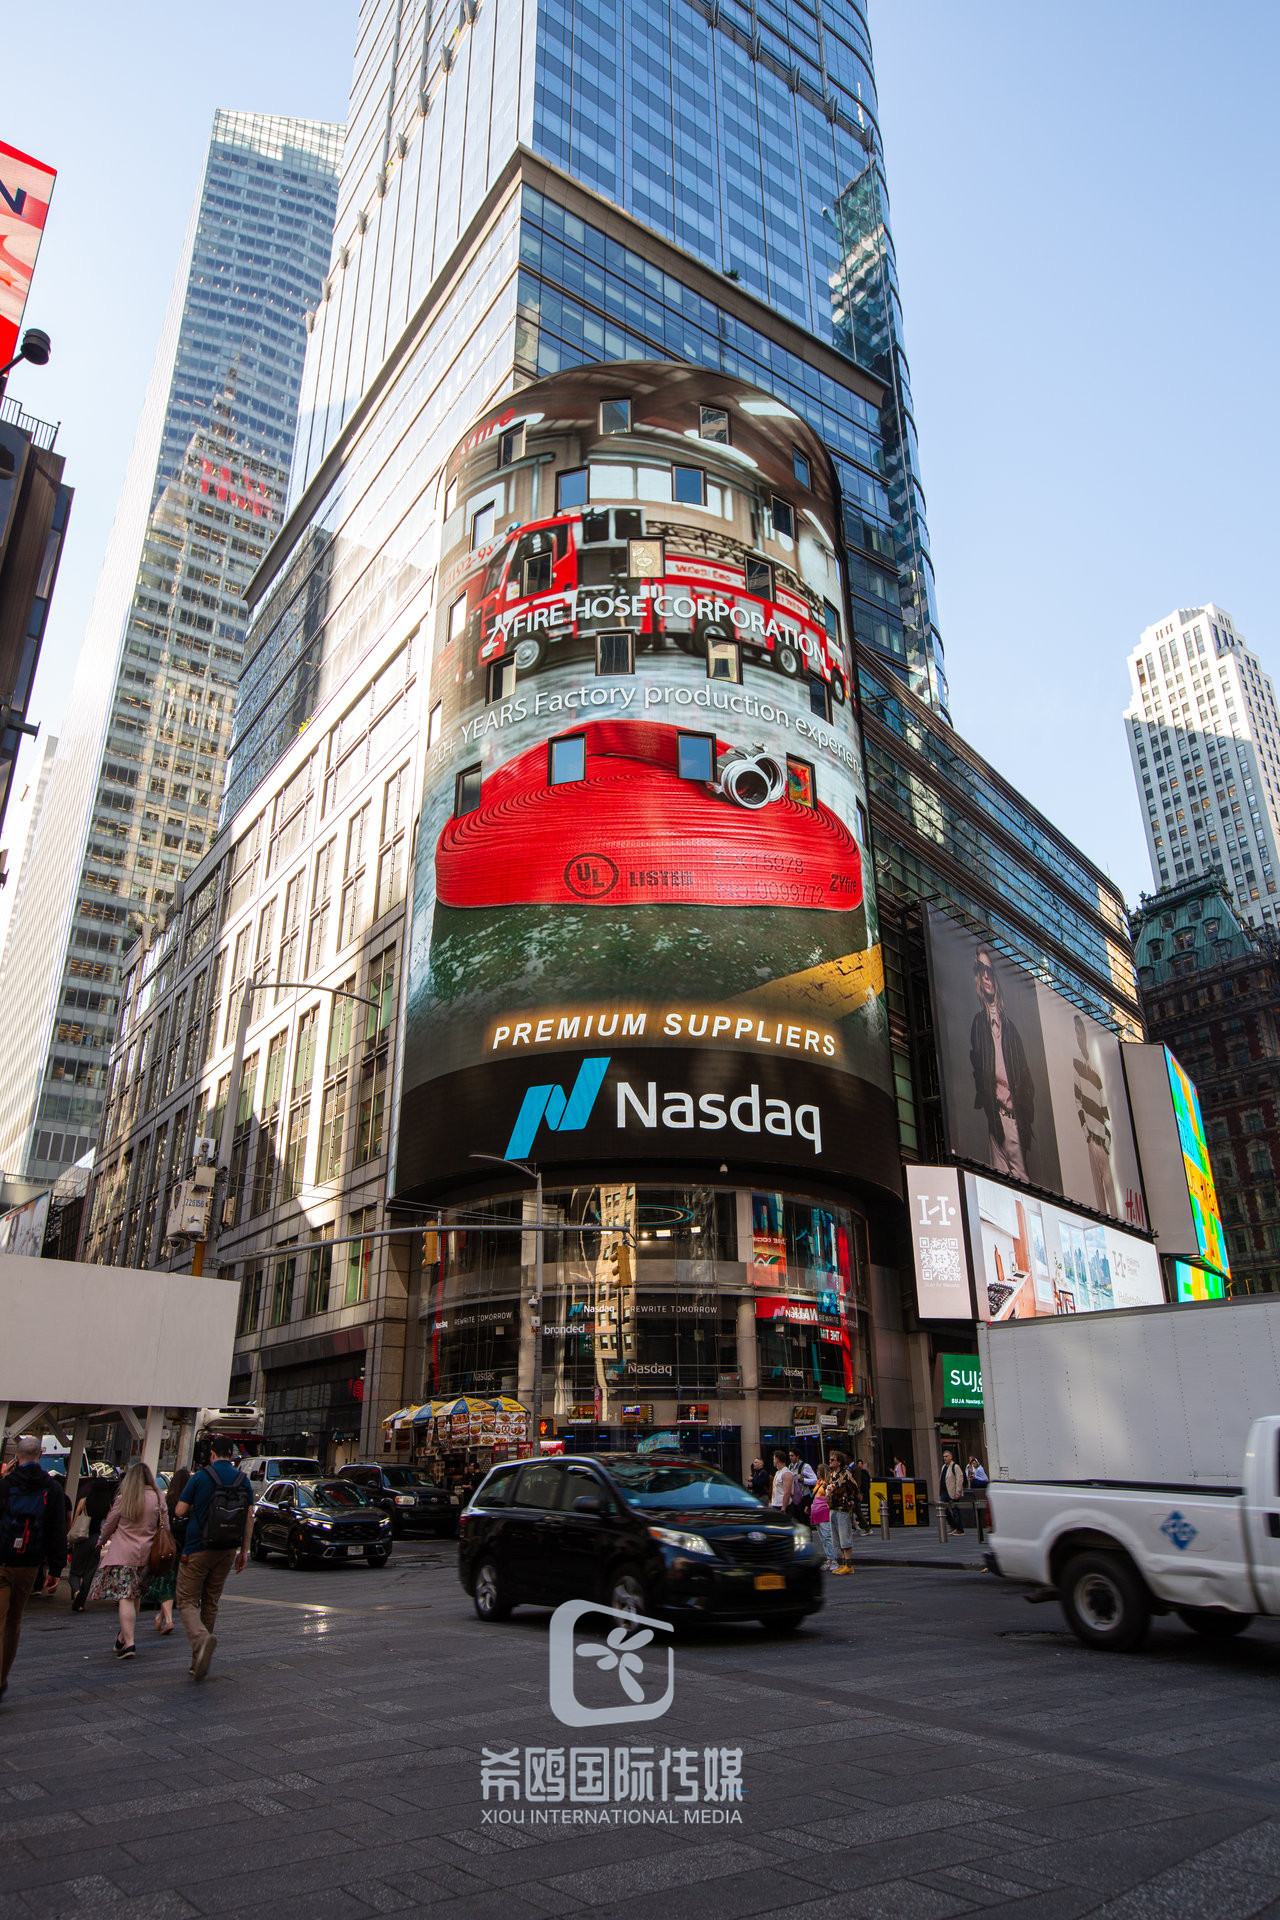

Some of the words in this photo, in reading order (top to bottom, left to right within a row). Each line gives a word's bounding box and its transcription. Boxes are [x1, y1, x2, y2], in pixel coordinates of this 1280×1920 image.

[486, 599, 564, 648] ZYFIRE
[572, 595, 647, 622] HOSE
[653, 595, 827, 667] CORPORATION
[461, 698, 528, 744] YEARS
[534, 686, 637, 716] Factory
[644, 685, 789, 728] production
[629, 871, 693, 888] LISTED
[492, 1012, 647, 1050] PREMIUM
[663, 1012, 836, 1057] SUPPLIERS
[616, 1081, 823, 1155] Nasdaq
[477, 1311, 513, 1322] TOMORROW
[584, 1304, 615, 1315] Nasdaq
[630, 1305, 667, 1314] REWRITE
[670, 1305, 718, 1314] TOMORROW
[628, 1363, 673, 1376] Nasdaq
